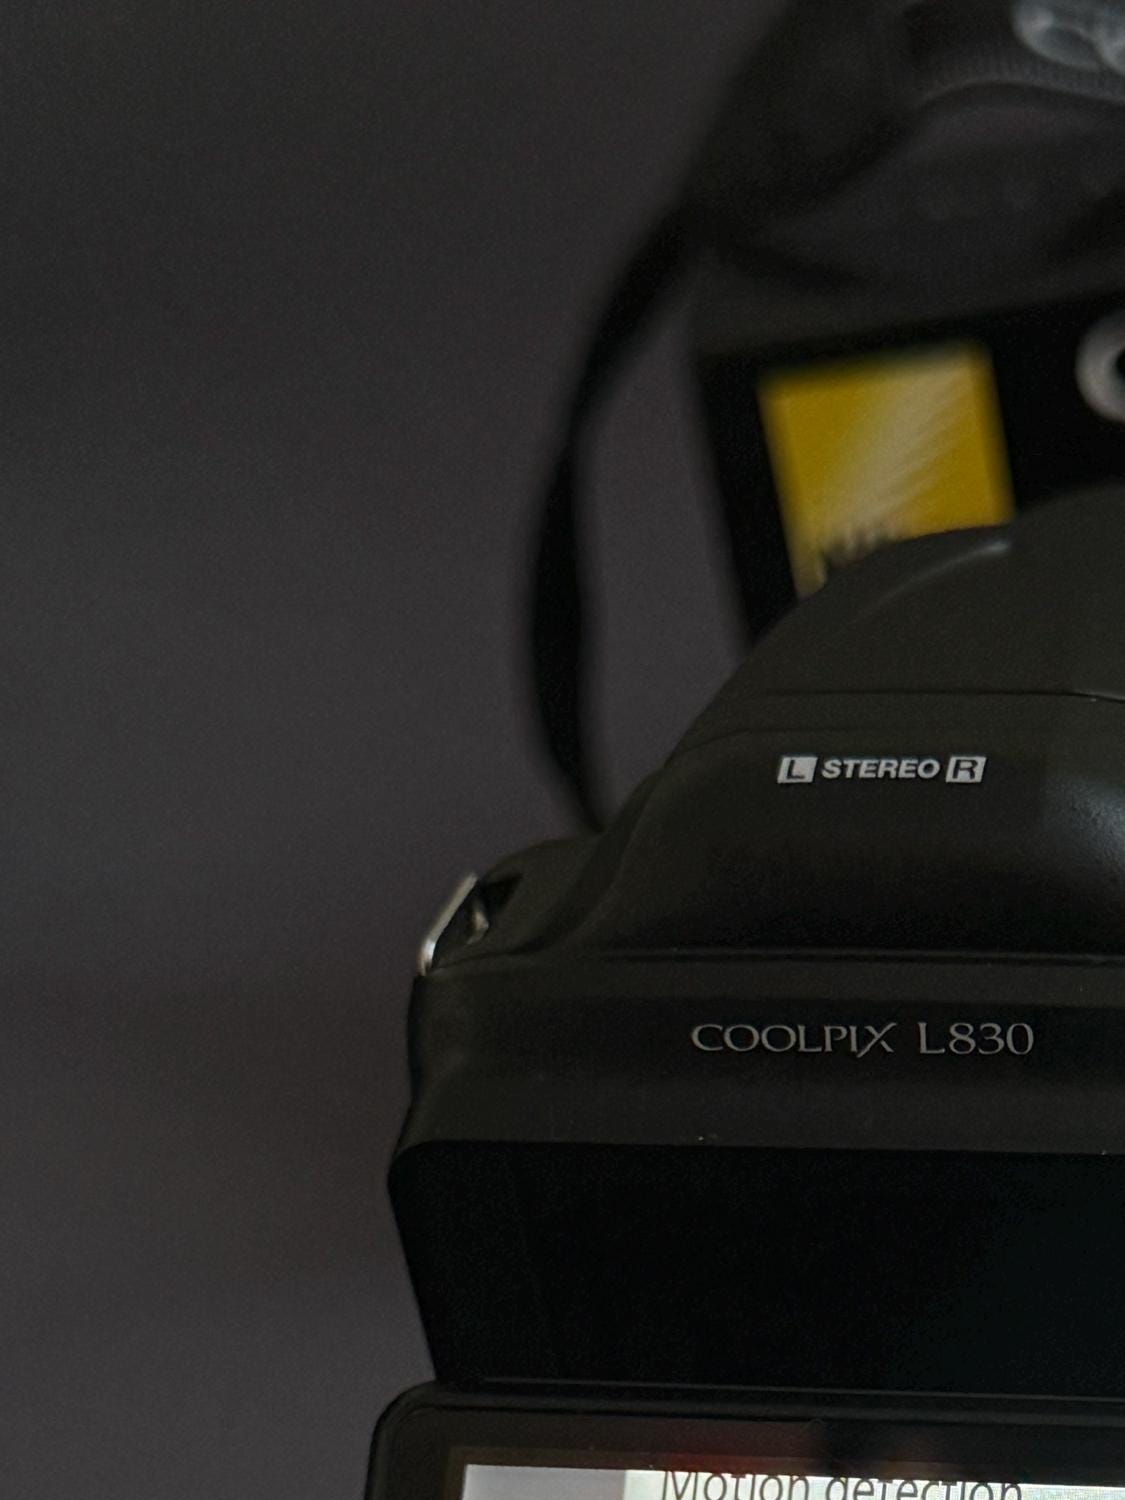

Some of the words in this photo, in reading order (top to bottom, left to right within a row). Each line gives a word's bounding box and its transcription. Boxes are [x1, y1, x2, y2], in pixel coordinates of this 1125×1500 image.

[821, 758, 940, 780] STEREO
[691, 1022, 898, 1058] COOLPIX
[919, 1022, 1035, 1056] L830
